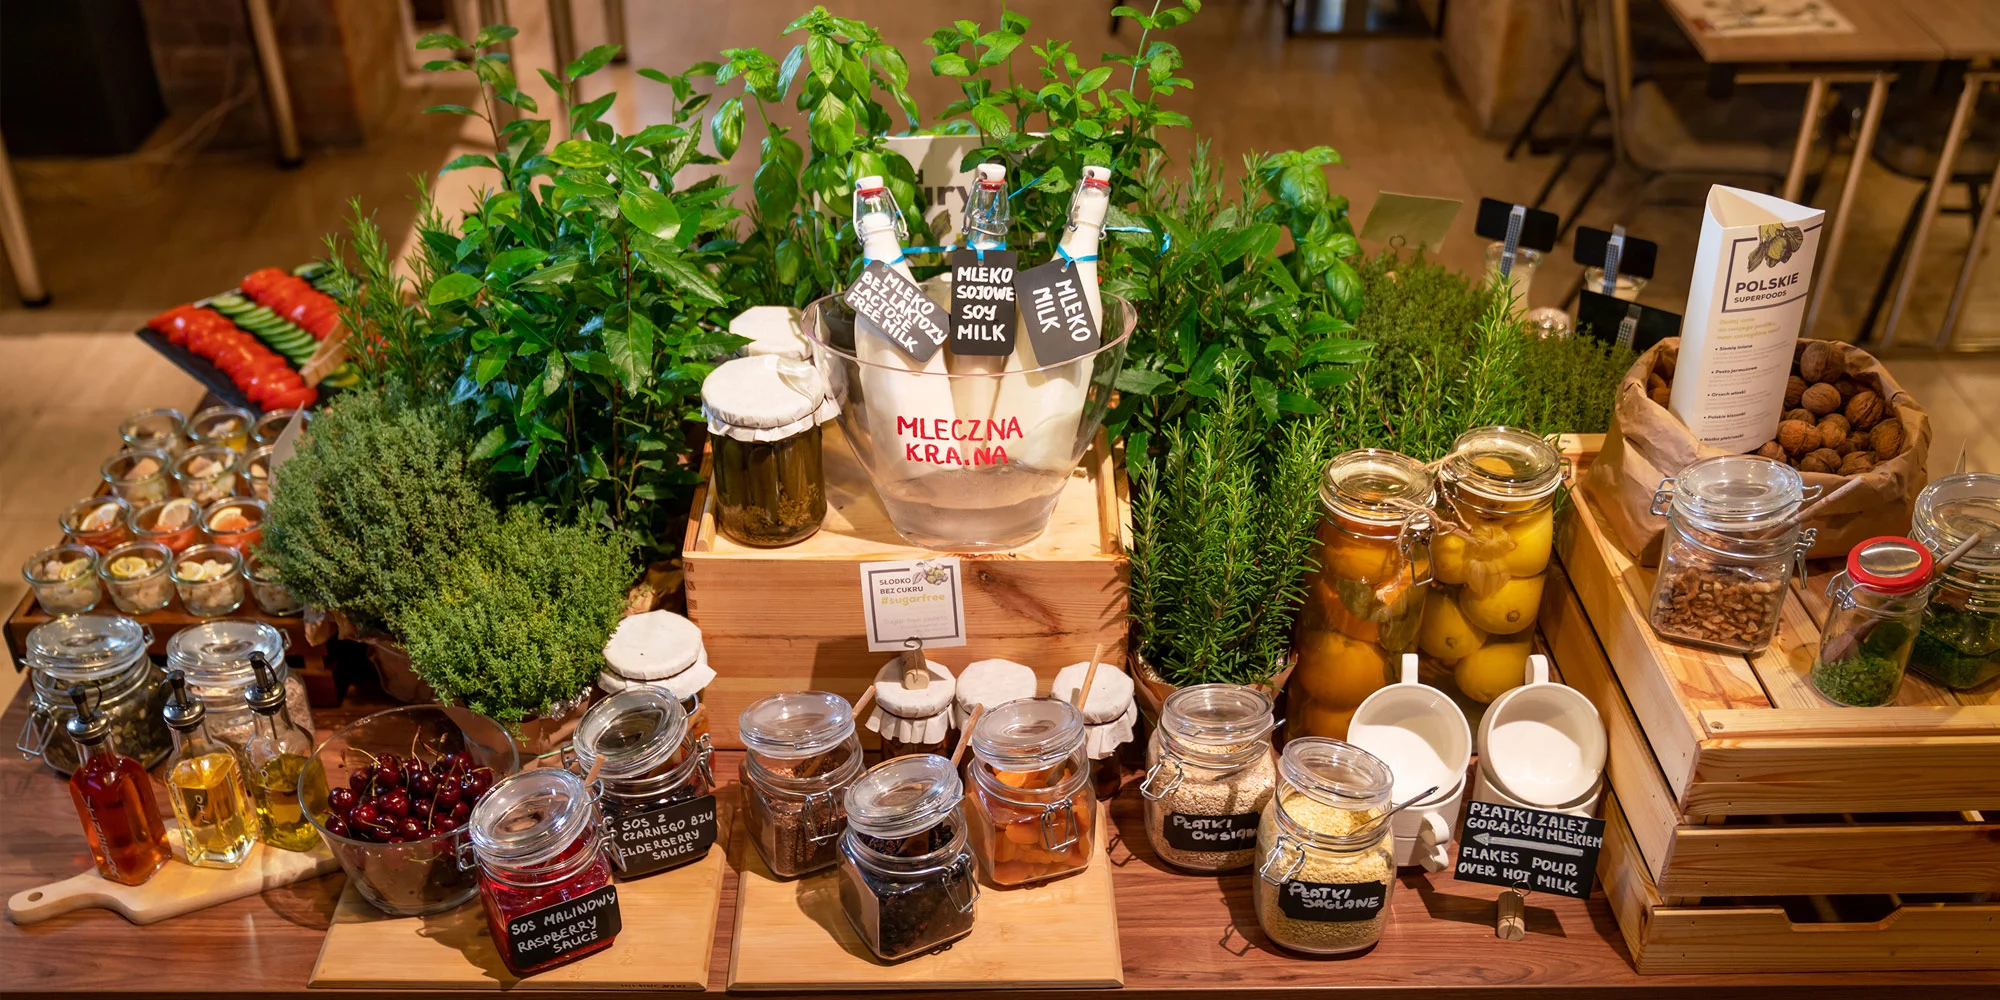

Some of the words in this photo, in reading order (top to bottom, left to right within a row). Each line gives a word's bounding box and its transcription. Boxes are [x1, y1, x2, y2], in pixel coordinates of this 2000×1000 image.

[957, 266, 1013, 284] MLEKO
[1735, 272, 1799, 294] POLSKIE
[884, 272, 935, 316] MLEKO
[957, 285, 1015, 302] SOJOWE
[1734, 290, 1787, 304] SUPERFOODS
[853, 282, 913, 333] LACTOSE
[861, 271, 887, 298] BEZ
[887, 292, 948, 346] LAKTOZY
[962, 304, 997, 321] SOY
[1032, 287, 1060, 333] MILK
[1055, 279, 1091, 342] MLEKO
[847, 291, 881, 323] FREE
[881, 320, 918, 353] MILK
[957, 324, 1006, 342] MILK
[897, 415, 1023, 441] MLECZNA
[879, 577, 912, 586] SŁODKO
[880, 587, 895, 595] BEZ
[896, 586, 924, 594] CUKRU
[881, 593, 945, 606] #sugarfree
[621, 818, 650, 831] SOS
[622, 819, 686, 842] CZARNEGO
[690, 811, 713, 826] BZU
[1172, 816, 1232, 831] PŁATKI
[1470, 802, 1533, 825] PŁATKI
[1536, 813, 1589, 834] ZALEJ
[620, 829, 700, 858] ELDERBERRY
[1466, 817, 1544, 839] GORĄCYM
[1546, 828, 1603, 849] MLEKIEM
[652, 842, 695, 861] SAUCE
[1462, 846, 1519, 865] FLAKES
[1531, 856, 1578, 877] POUR
[1288, 881, 1351, 899] PŁATKI
[1458, 862, 1498, 877] OVER
[1502, 868, 1531, 883] HOT
[1536, 874, 1578, 895] MILK
[511, 920, 536, 936] SOS
[544, 891, 616, 926] MALINOWY
[1302, 896, 1379, 909] JAGLANE
[517, 915, 597, 953] RASPBERRY
[552, 930, 598, 953] SAUCE
